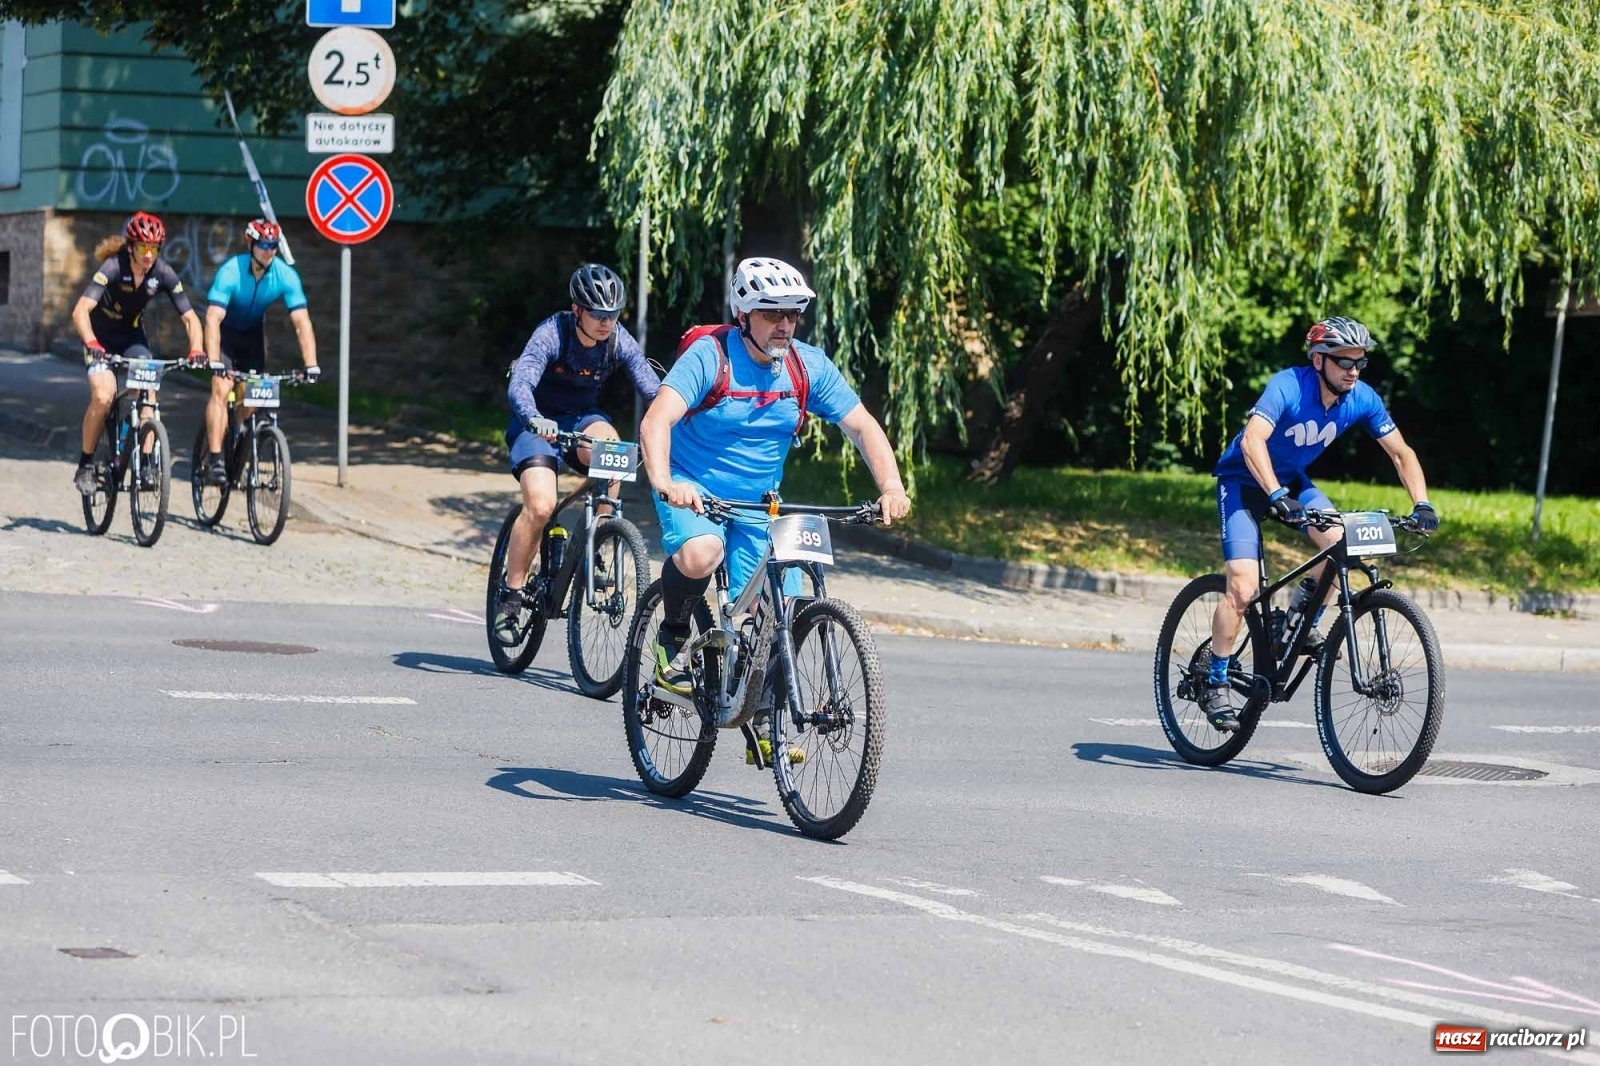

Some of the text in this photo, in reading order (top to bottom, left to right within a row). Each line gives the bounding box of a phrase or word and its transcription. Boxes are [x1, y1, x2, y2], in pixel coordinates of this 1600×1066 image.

[313, 120, 387, 134] Nie dotyczy
[600, 453, 629, 469] 1939
[784, 530, 822, 547] 589
[1355, 526, 1384, 541] 1201
